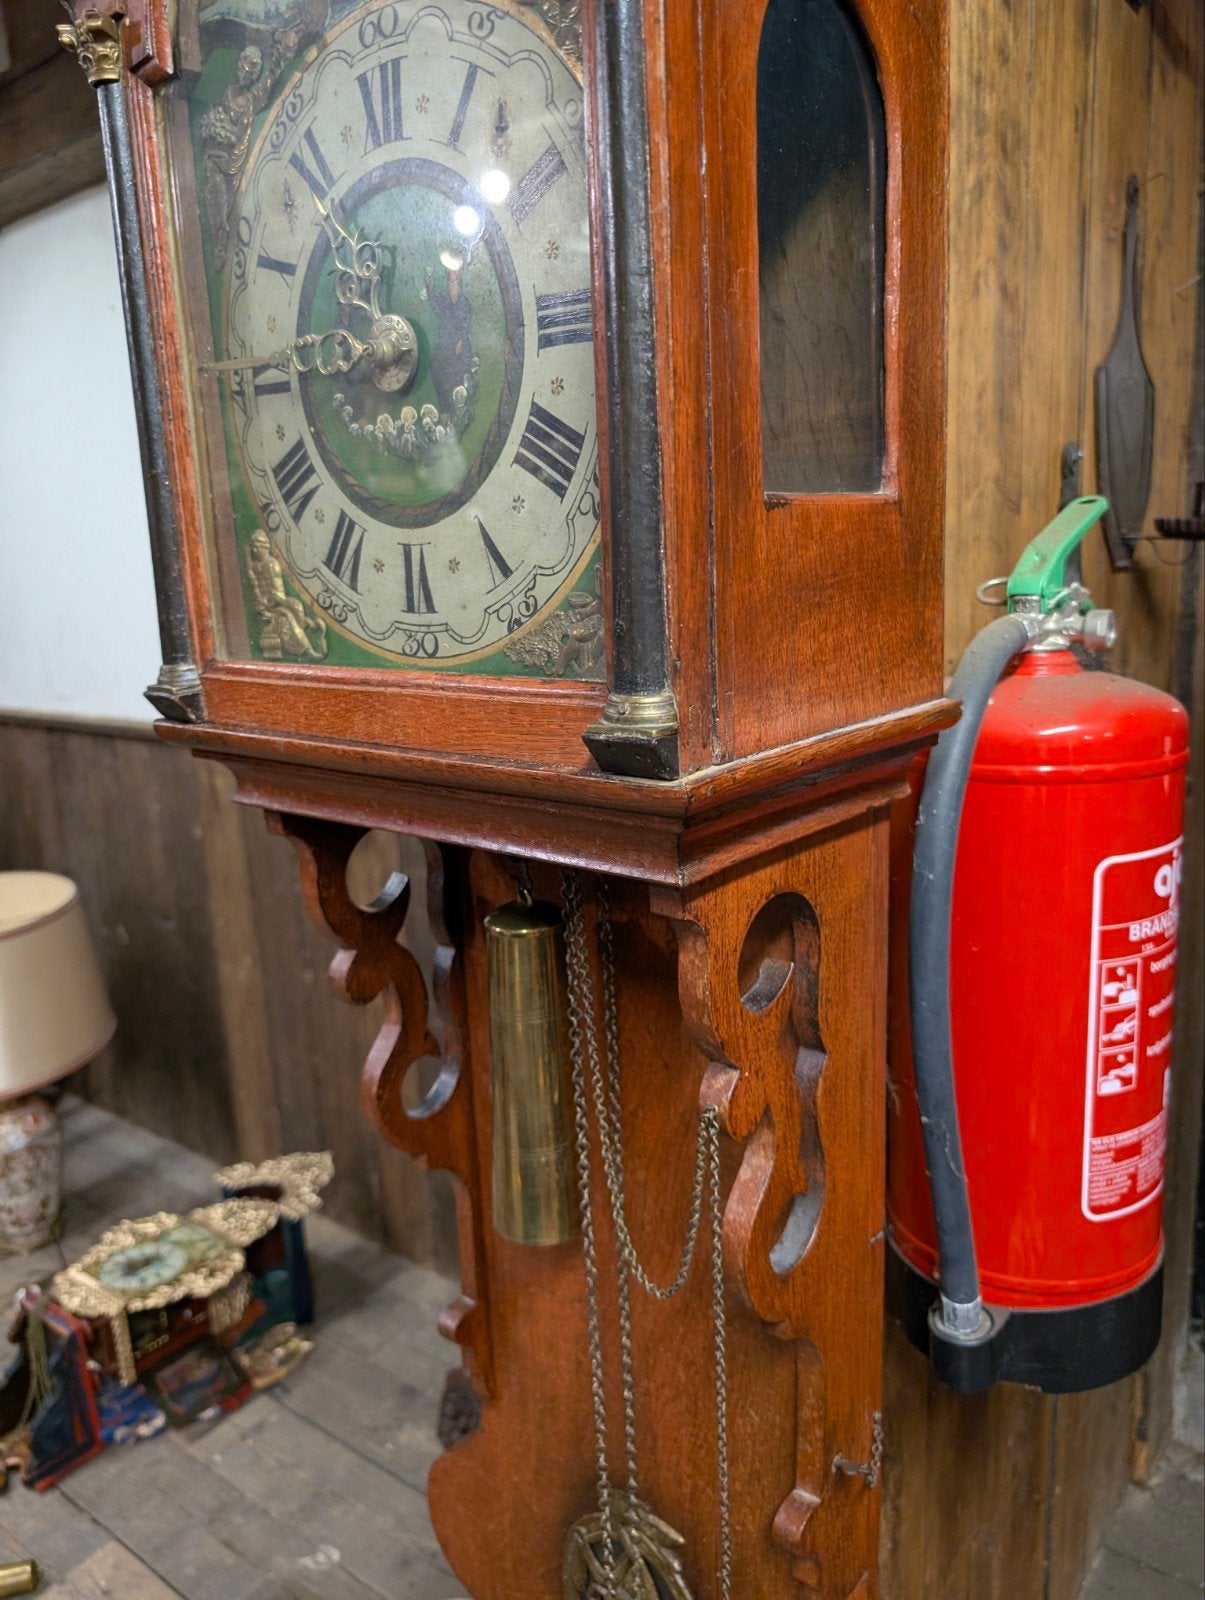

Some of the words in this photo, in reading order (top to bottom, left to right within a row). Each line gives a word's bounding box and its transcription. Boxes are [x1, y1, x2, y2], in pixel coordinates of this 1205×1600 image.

[358, 5, 399, 49] 60
[270, 88, 304, 150] 55
[354, 55, 412, 158] XII
[505, 122, 572, 232] II
[233, 215, 253, 279] 50
[253, 222, 305, 292] X
[532, 284, 592, 357] III
[270, 432, 324, 533] VIII
[510, 392, 588, 504] IIII
[322, 508, 368, 596] VII
[397, 541, 439, 615] VI
[473, 514, 524, 594] V
[316, 582, 357, 624] 35
[497, 577, 538, 634] 25
[402, 629, 440, 659] 30
